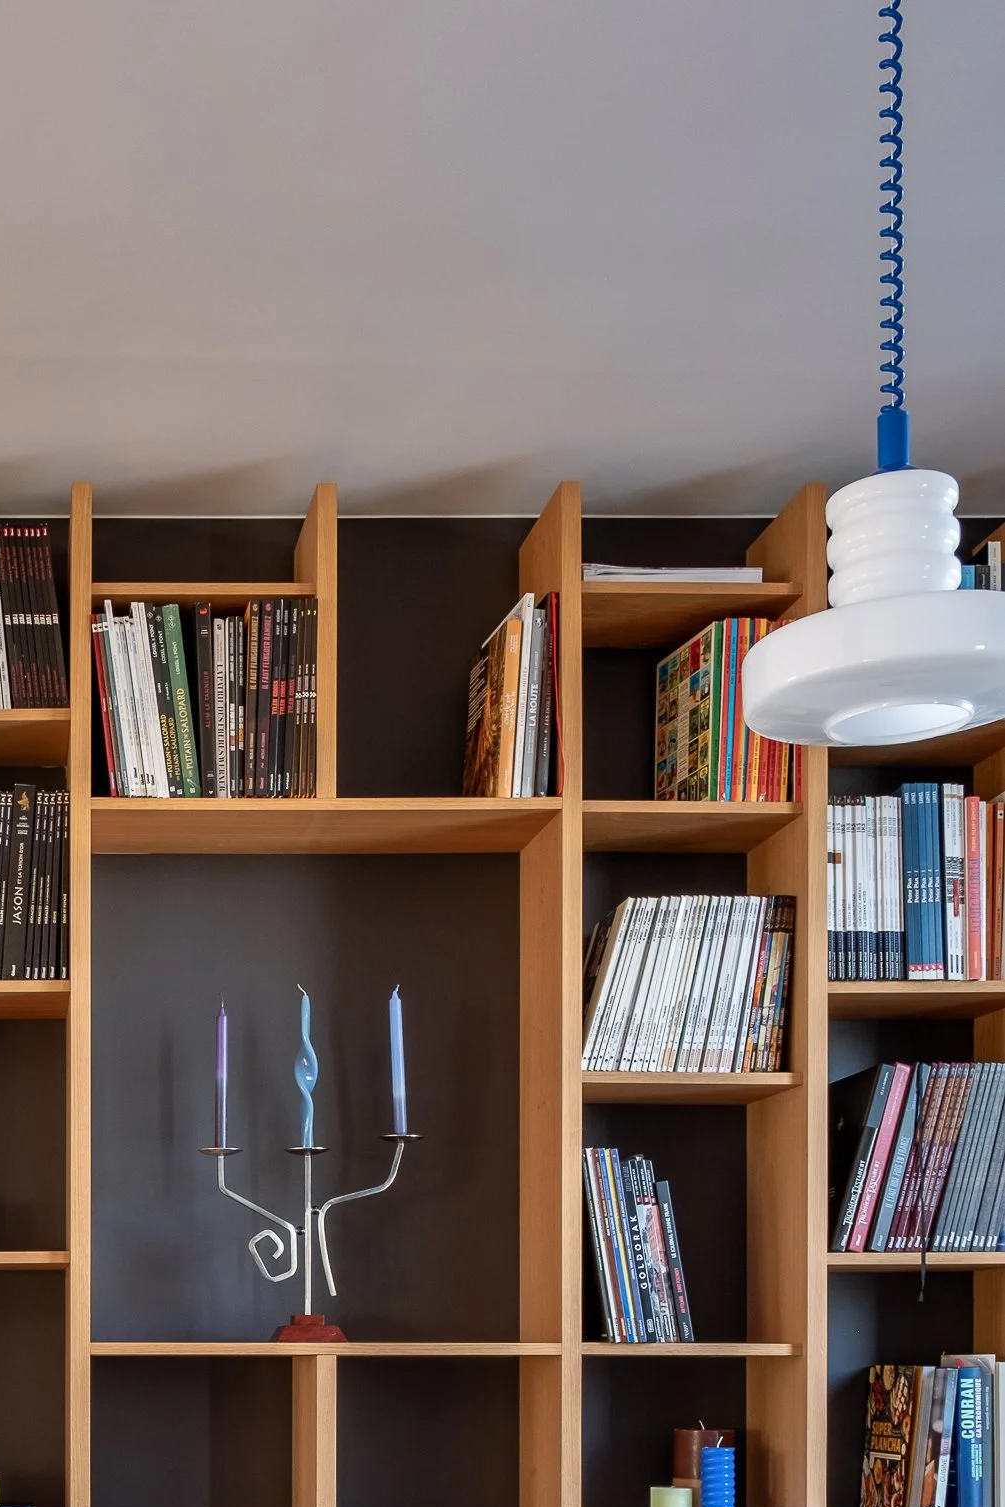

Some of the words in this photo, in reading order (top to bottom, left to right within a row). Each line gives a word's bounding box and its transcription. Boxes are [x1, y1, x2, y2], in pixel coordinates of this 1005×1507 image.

[176, 688, 189, 733] SALOPARD
[529, 684, 538, 713] ROUTE
[160, 714, 170, 747] SALOPARD
[168, 718, 176, 750] SALOPARD
[529, 716, 536, 727] LA
[182, 739, 193, 770] PUTAIN
[12, 887, 23, 924] JASON
[893, 1164, 902, 1176] FOIS
[898, 1137, 909, 1156] FRANCE
[851, 1160, 865, 1193] TESTAMENT
[867, 1160, 880, 1194] TESTAMENT
[630, 1215, 647, 1289] GOLDORAK
[961, 1378, 975, 1439] CONRAN
[871, 1436, 900, 1452] PLANCHA
[872, 1422, 892, 1436] SUPER
